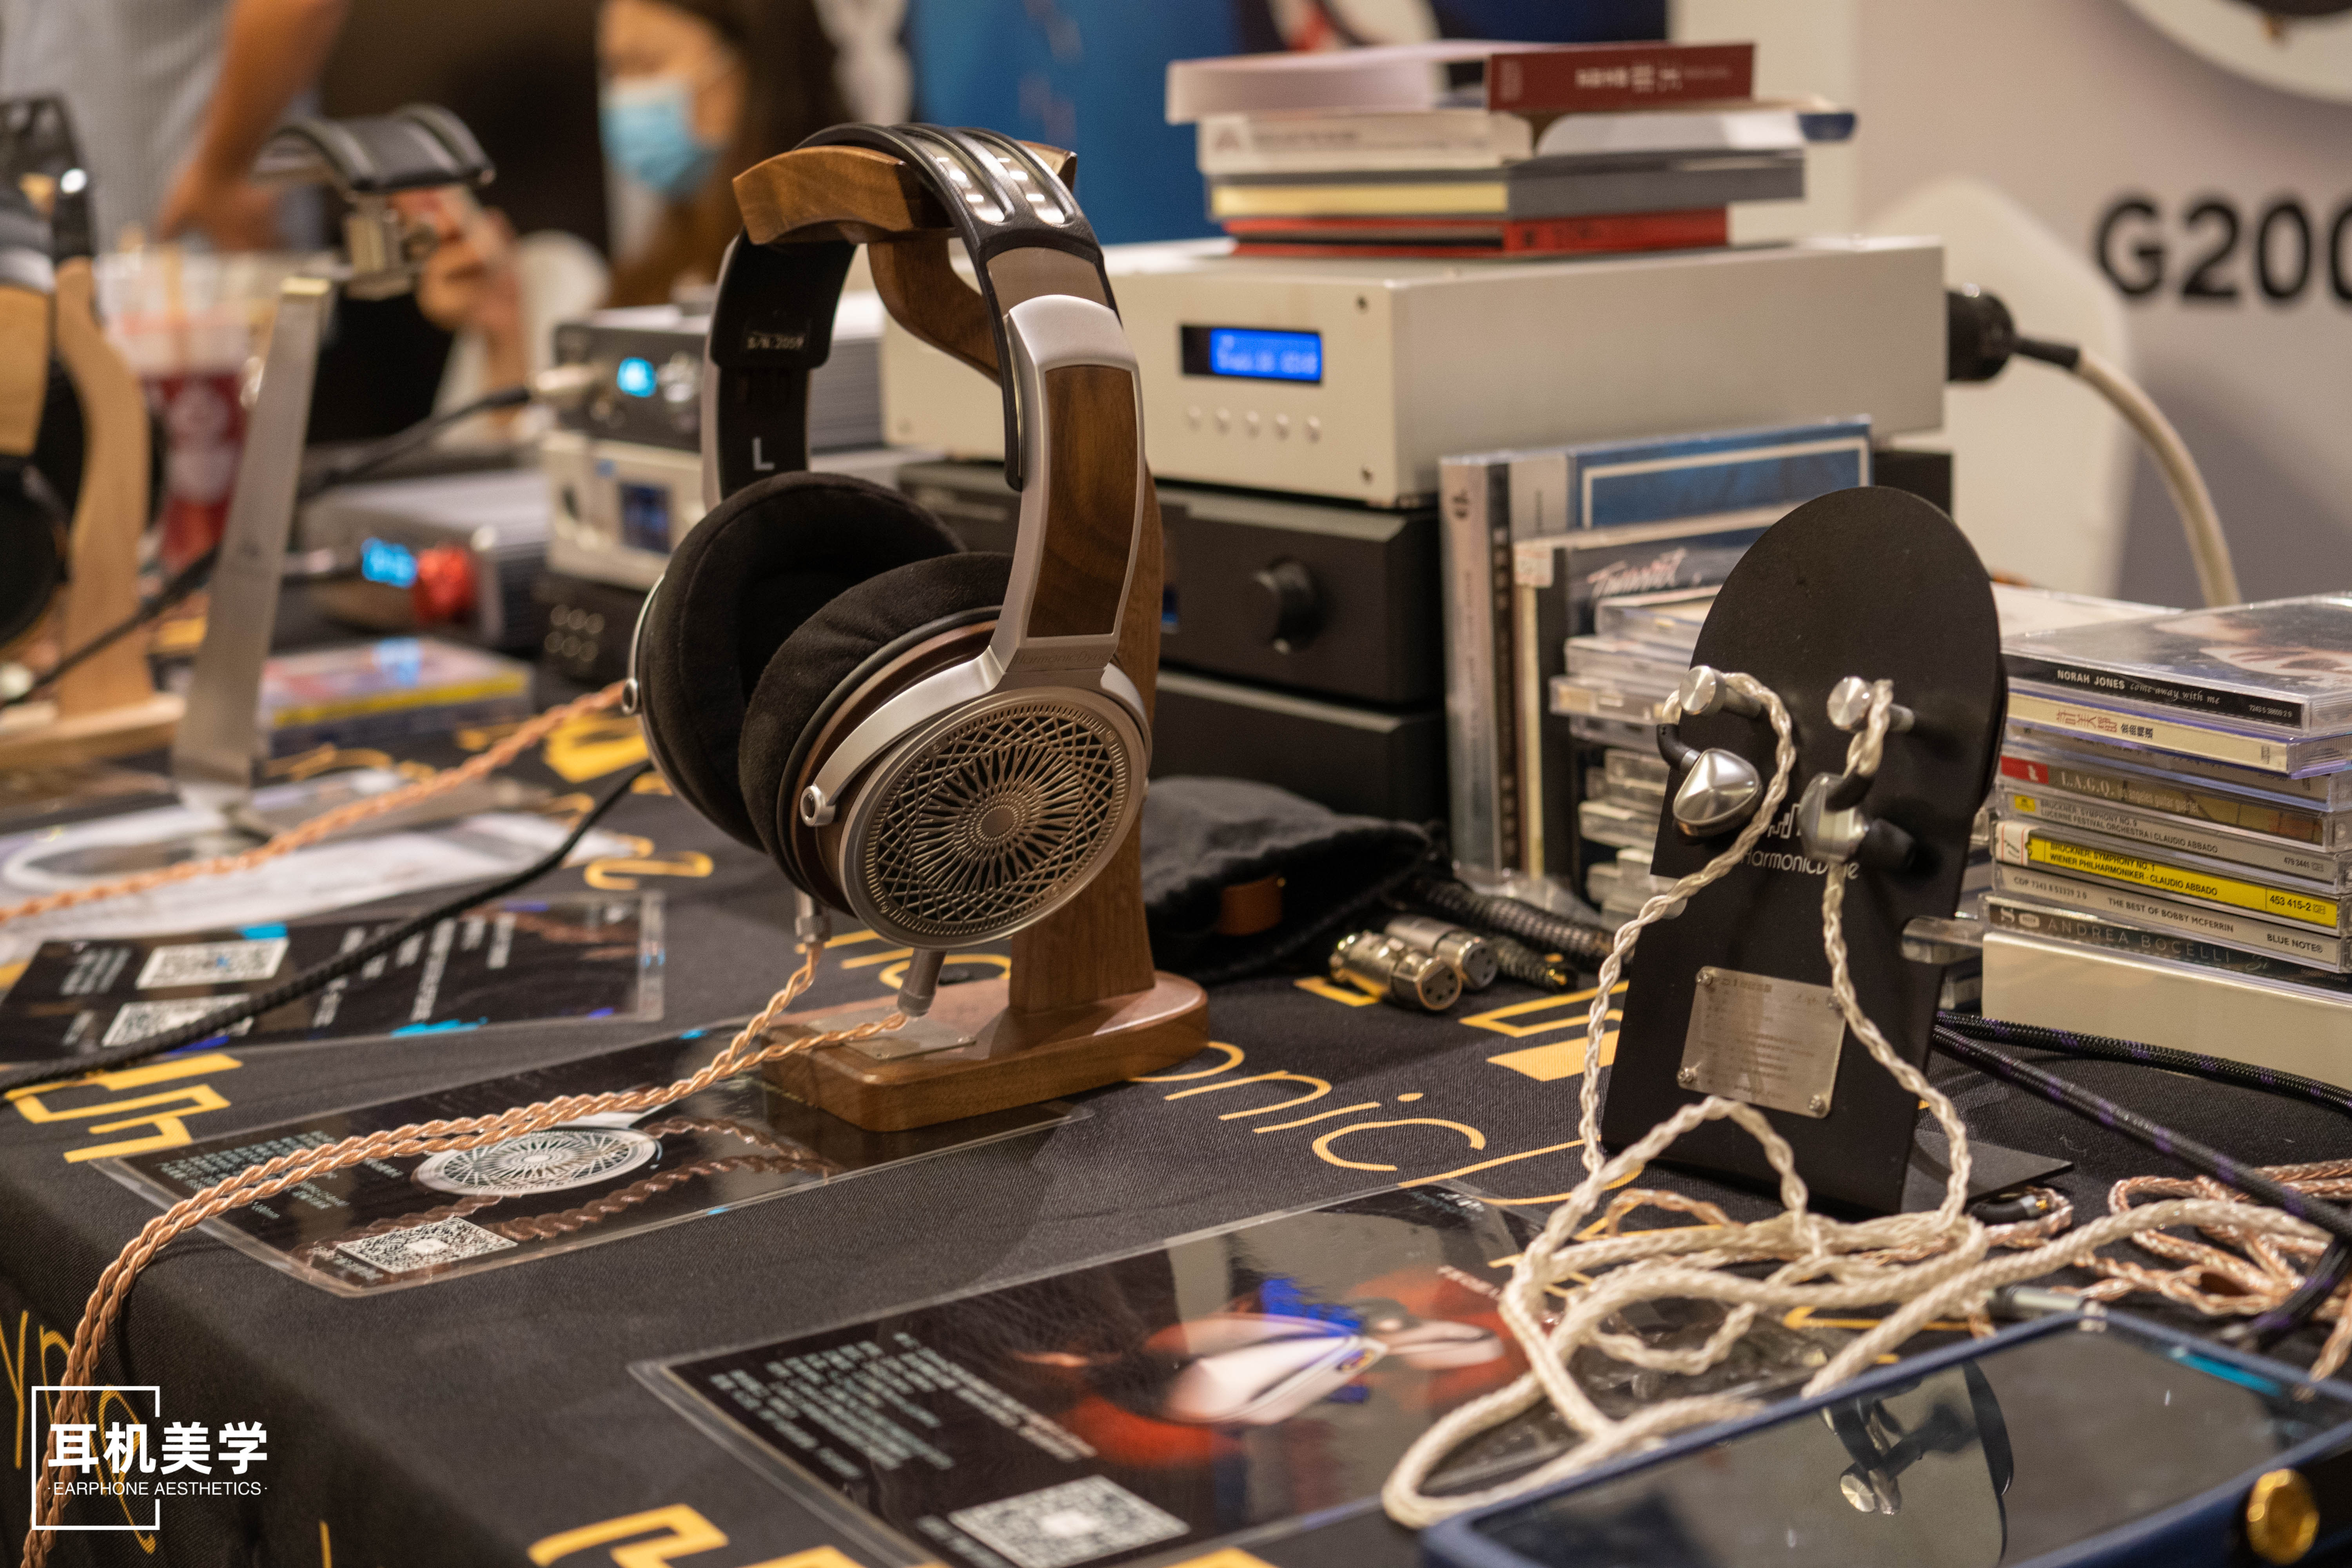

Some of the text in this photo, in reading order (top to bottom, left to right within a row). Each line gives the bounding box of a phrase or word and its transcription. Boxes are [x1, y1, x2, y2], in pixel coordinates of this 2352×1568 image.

[752, 437, 775, 470] L
[2057, 669, 2090, 684] NORAH
[2094, 676, 2125, 690] JONES
[2155, 687, 2179, 701] away
[2182, 690, 2203, 702] with
[2207, 696, 2220, 704] me
[2073, 814, 2105, 829] FESTIVAL
[2106, 822, 2149, 838] ORCHESTRA
[2154, 833, 2186, 847] CLAUDIO
[2187, 839, 2218, 854] ABBADO
[2050, 852, 2218, 896] WIENER PHILHARMONIKER CLAUDIO ABBADO
[2093, 850, 2135, 867] SYMPHONY
[2136, 860, 2150, 871] NO.
[2151, 863, 2155, 872] 1
[2109, 897, 2234, 933] THE BEST OF BOBBY MCFERRIN
[2270, 895, 2285, 906] 453
[2287, 898, 2311, 911] 415-2
[2048, 918, 2129, 945] ANDREA
[2141, 935, 2230, 963] BOCELLI
[2267, 933, 2289, 946] BLUE
